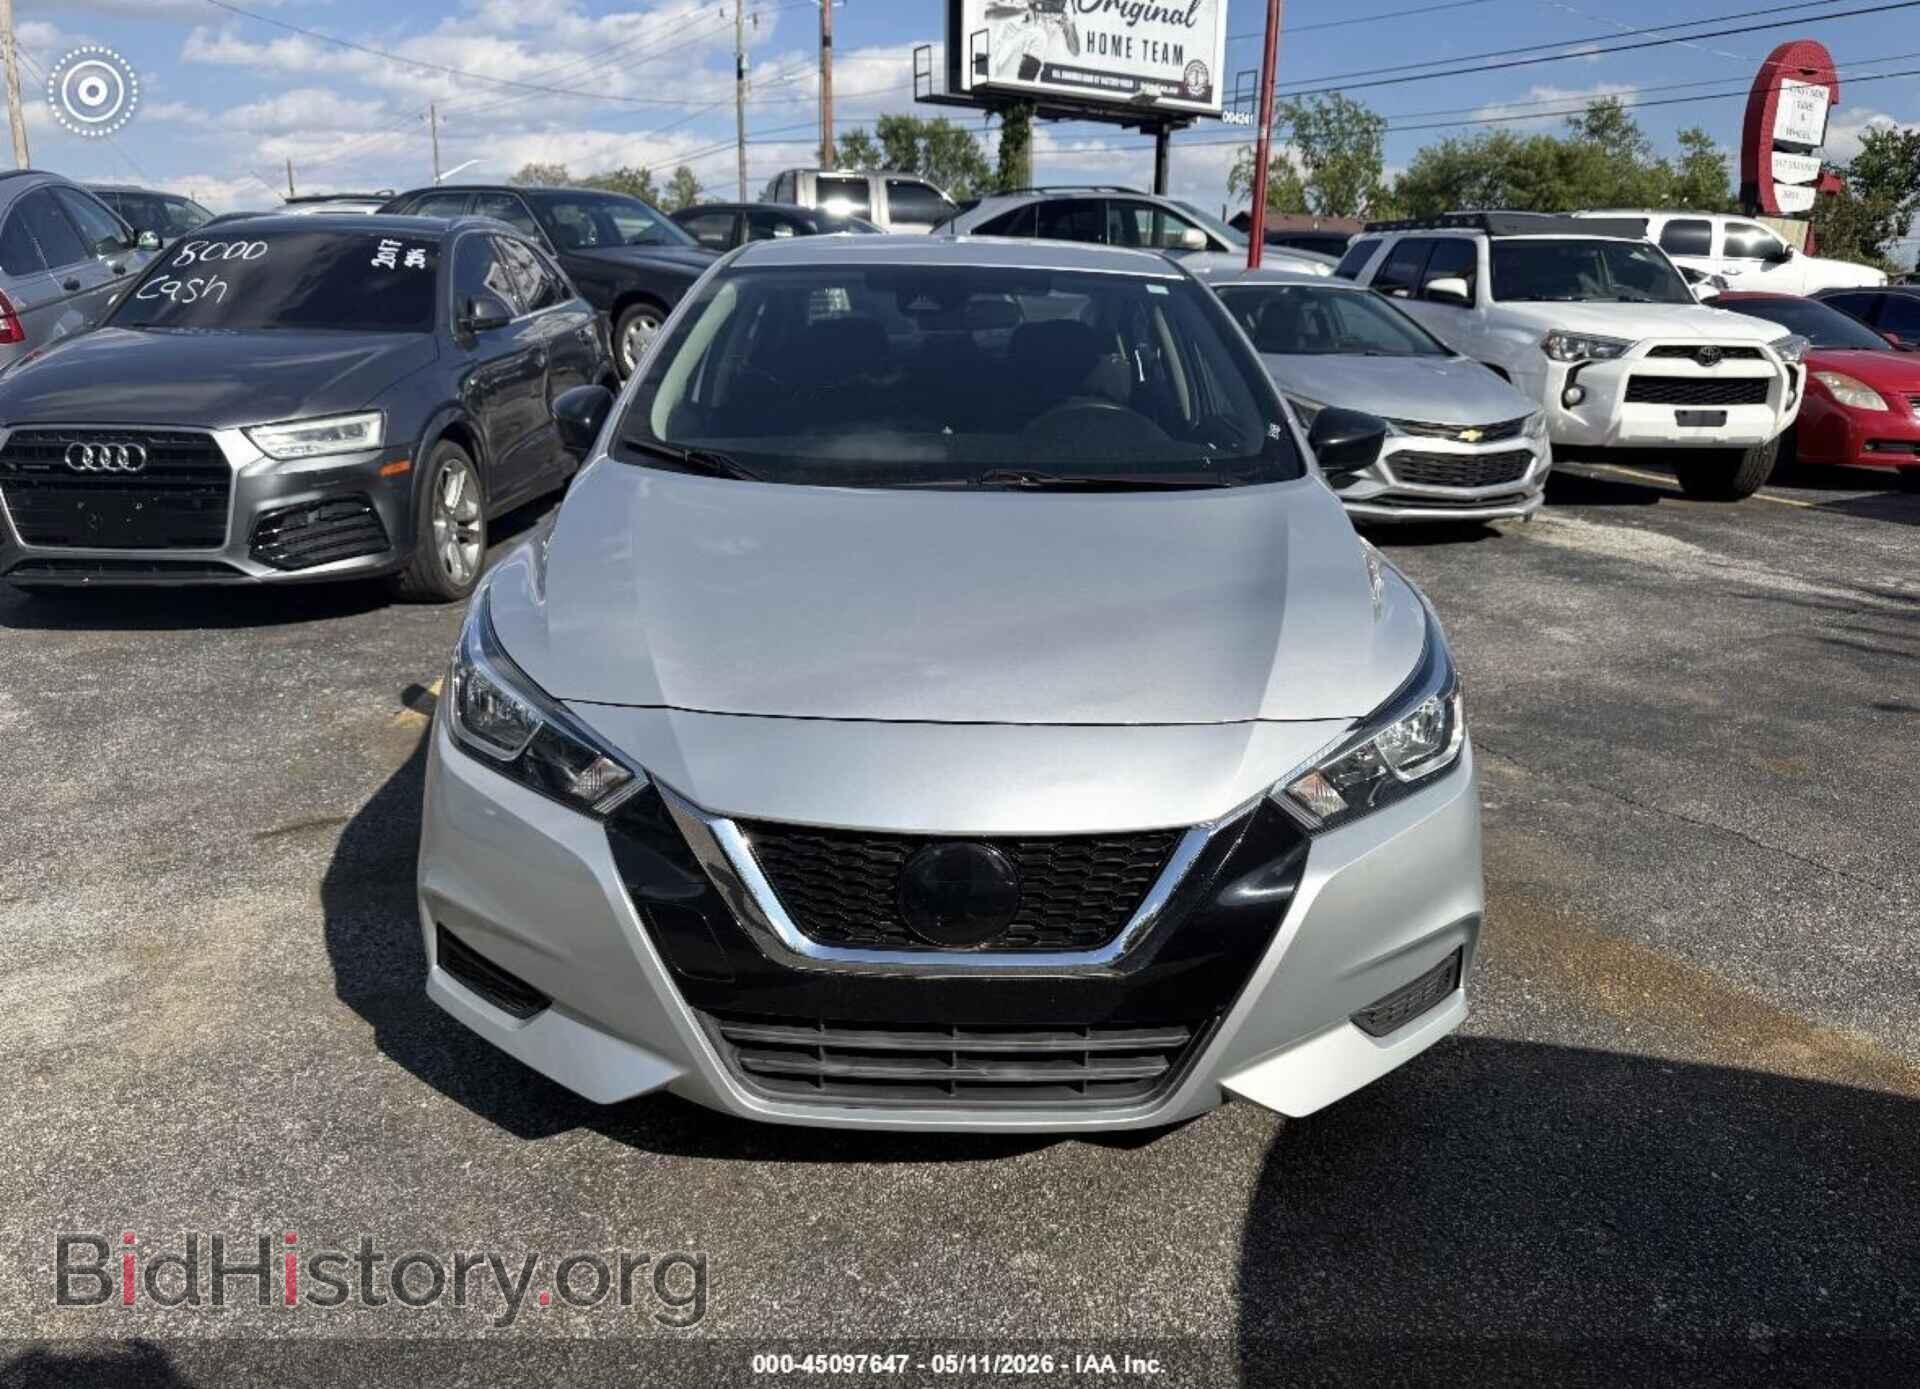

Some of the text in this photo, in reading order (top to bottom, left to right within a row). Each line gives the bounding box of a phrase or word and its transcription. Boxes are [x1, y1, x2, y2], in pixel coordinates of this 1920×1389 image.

[1087, 30, 1184, 66] HOME TEAM
[172, 240, 268, 267] 8000
[371, 239, 402, 269] 2017
